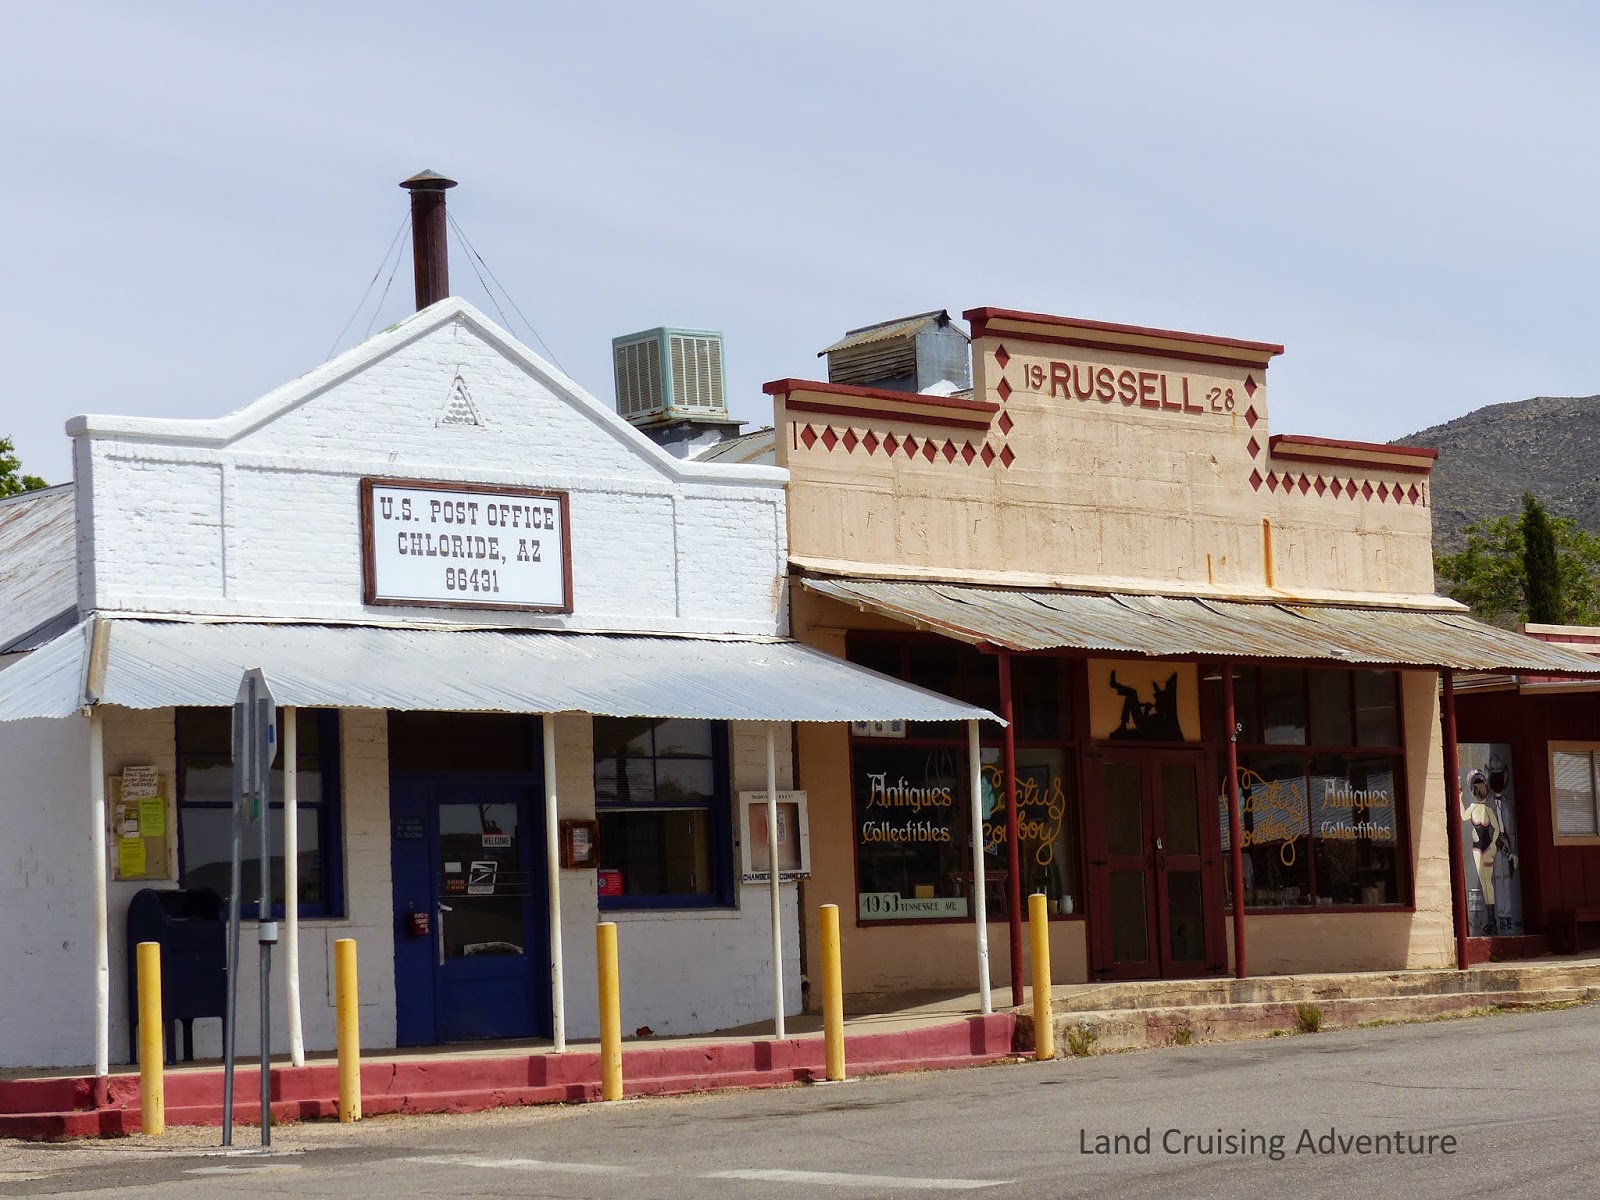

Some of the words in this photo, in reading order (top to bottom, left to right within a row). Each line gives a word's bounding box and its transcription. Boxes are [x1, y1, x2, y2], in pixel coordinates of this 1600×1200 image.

[1050, 361, 1204, 414] RUSSELL
[380, 496, 419, 522] U.S.
[430, 499, 479, 525] POST
[487, 503, 554, 530] OFFICE
[398, 531, 507, 564] CHLORIDE,
[516, 538, 541, 562] AZ
[446, 567, 499, 592] 86431
[865, 772, 952, 814] Antiques
[1321, 777, 1388, 813] Antiques
[483, 836, 510, 846] WELCOME
[861, 820, 950, 844] Collectibles
[982, 810, 1058, 866] oboy
[1228, 814, 1300, 866] owboy
[1320, 820, 1391, 842] Collectibles
[862, 894, 899, 913] 4953
[901, 902, 939, 912] TENNESSEE
